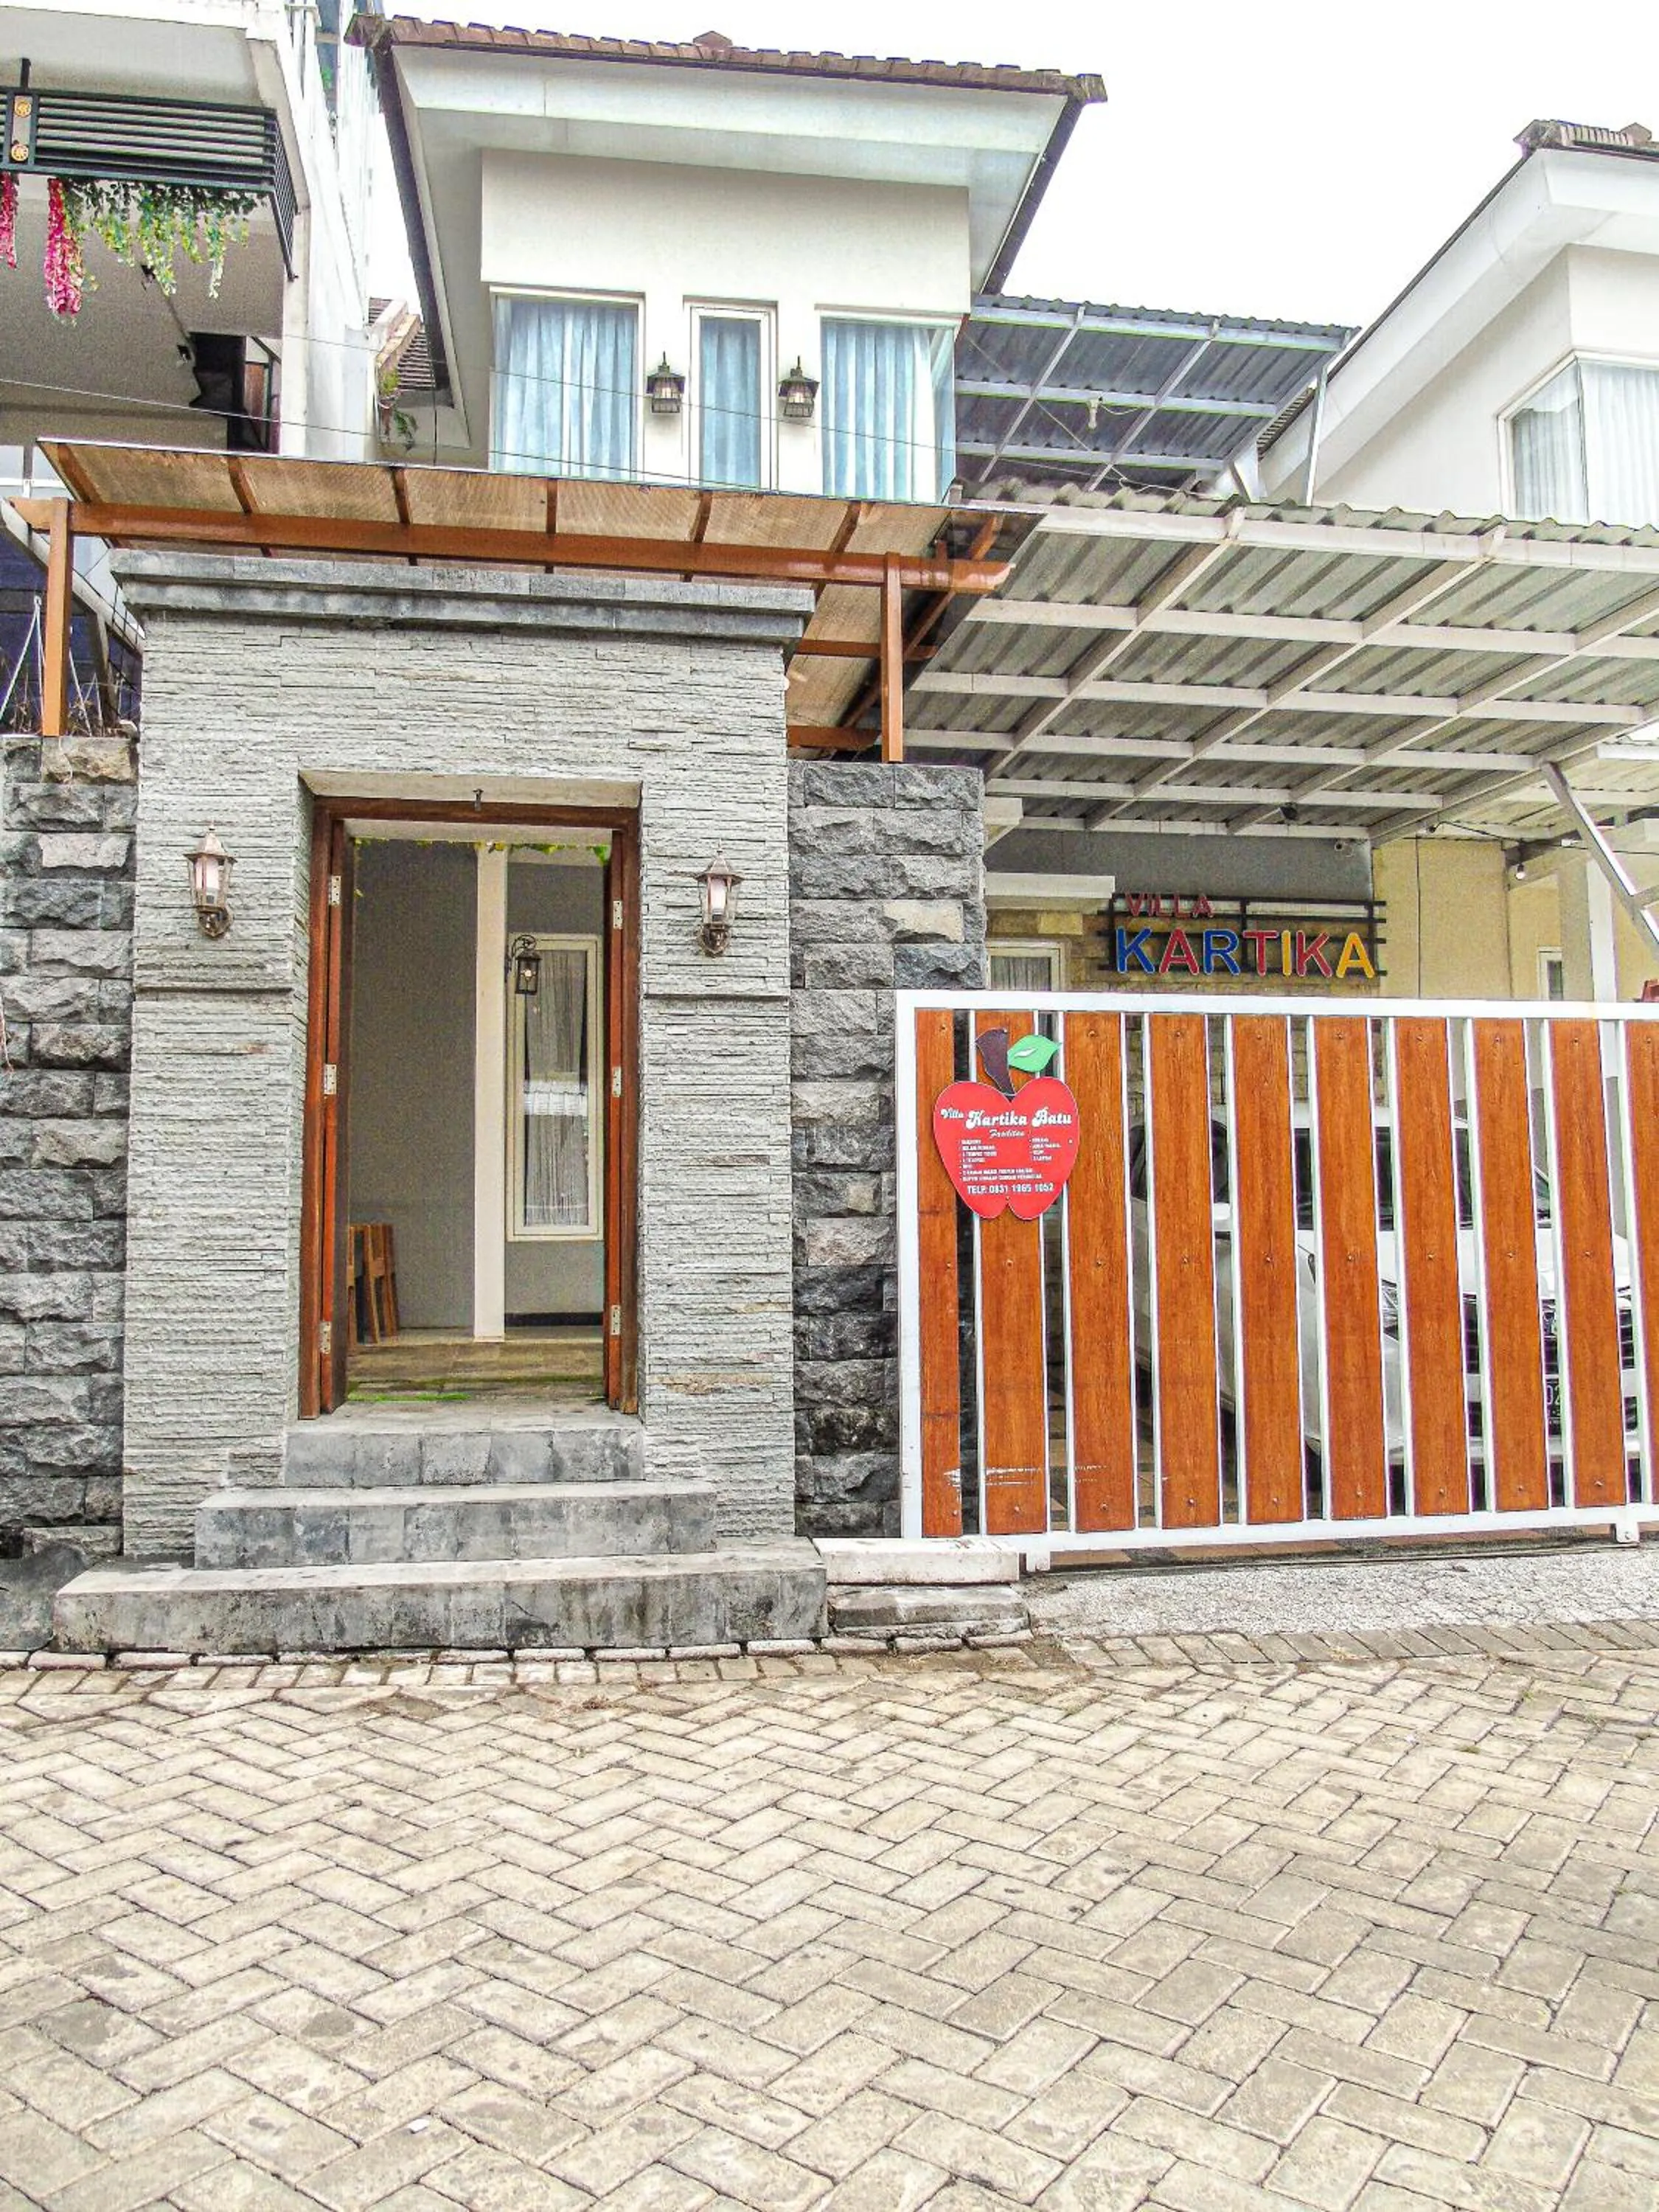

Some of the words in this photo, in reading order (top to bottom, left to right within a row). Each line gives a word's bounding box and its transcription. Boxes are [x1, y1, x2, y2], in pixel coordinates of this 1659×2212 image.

[1123, 892, 1216, 919] VILLA
[1115, 926, 1376, 979] KARTIKA
[965, 1108, 1028, 1129] Kartika
[1032, 1107, 1072, 1127] Batu
